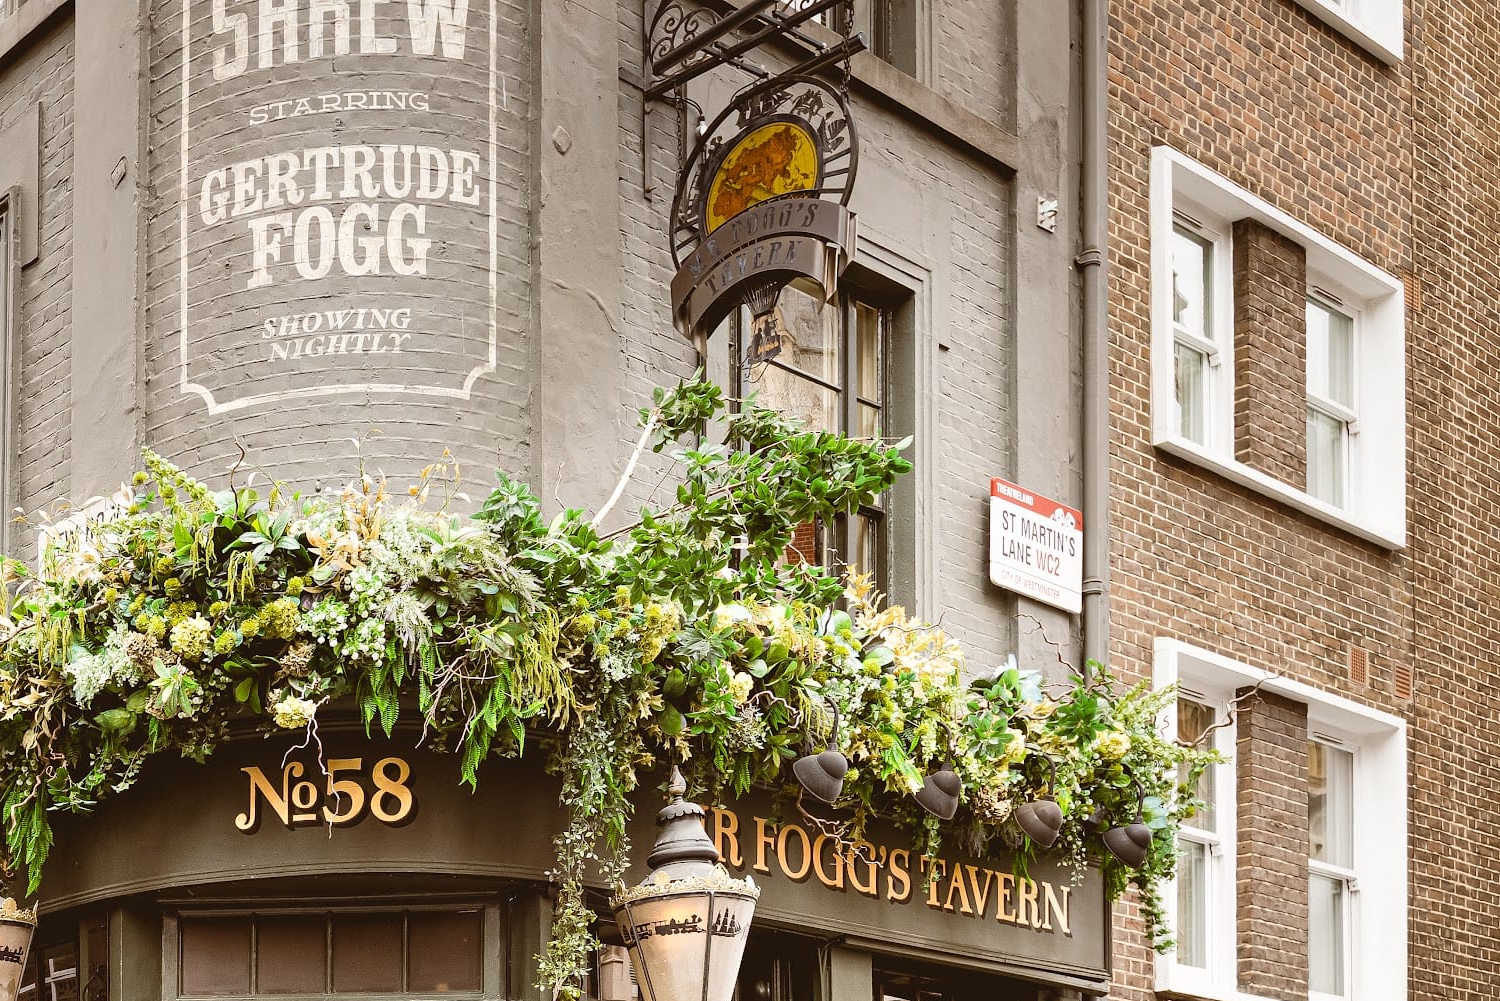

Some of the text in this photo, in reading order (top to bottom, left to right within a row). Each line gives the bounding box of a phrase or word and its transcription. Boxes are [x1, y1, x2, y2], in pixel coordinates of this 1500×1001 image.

[249, 92, 430, 126] STARRING
[200, 144, 480, 226] GERTRUDE
[731, 202, 819, 244] FOGG'S
[247, 202, 432, 289] FOGG
[704, 240, 802, 295] TAVERN
[262, 308, 411, 339] SHOWING
[268, 332, 411, 362] NIGHTLY
[996, 481, 1034, 507] THEATRELAND
[1002, 510, 1076, 557] ST MARTIN'S
[1002, 535, 1061, 577] LANE WC2
[323, 757, 413, 823] 58
[752, 815, 912, 901] FOGG'S
[920, 857, 1072, 935] TAVERN
